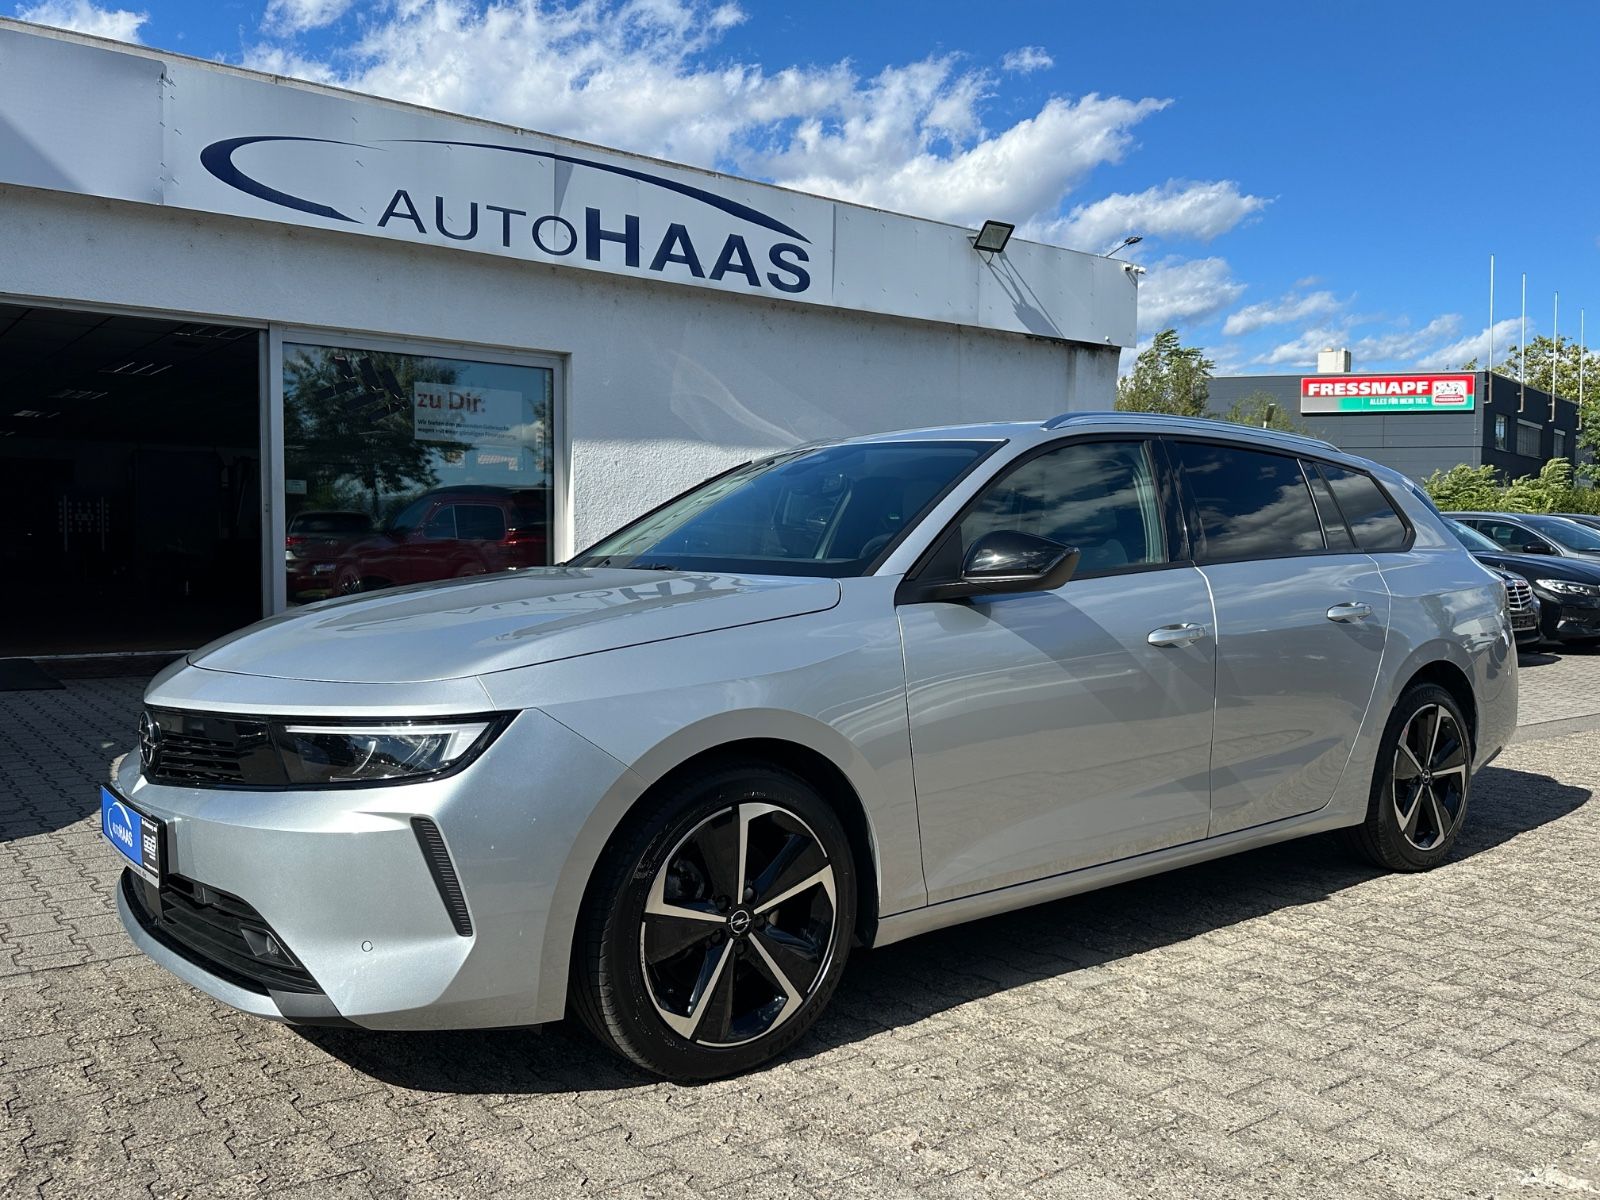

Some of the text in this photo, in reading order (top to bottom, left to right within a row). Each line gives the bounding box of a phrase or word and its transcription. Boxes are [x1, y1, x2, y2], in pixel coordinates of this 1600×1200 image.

[377, 188, 811, 294] AUTOHAAS
[1308, 381, 1429, 396] FRESSNAPF
[417, 393, 441, 409] zu
[1370, 397, 1387, 406] ALLES
